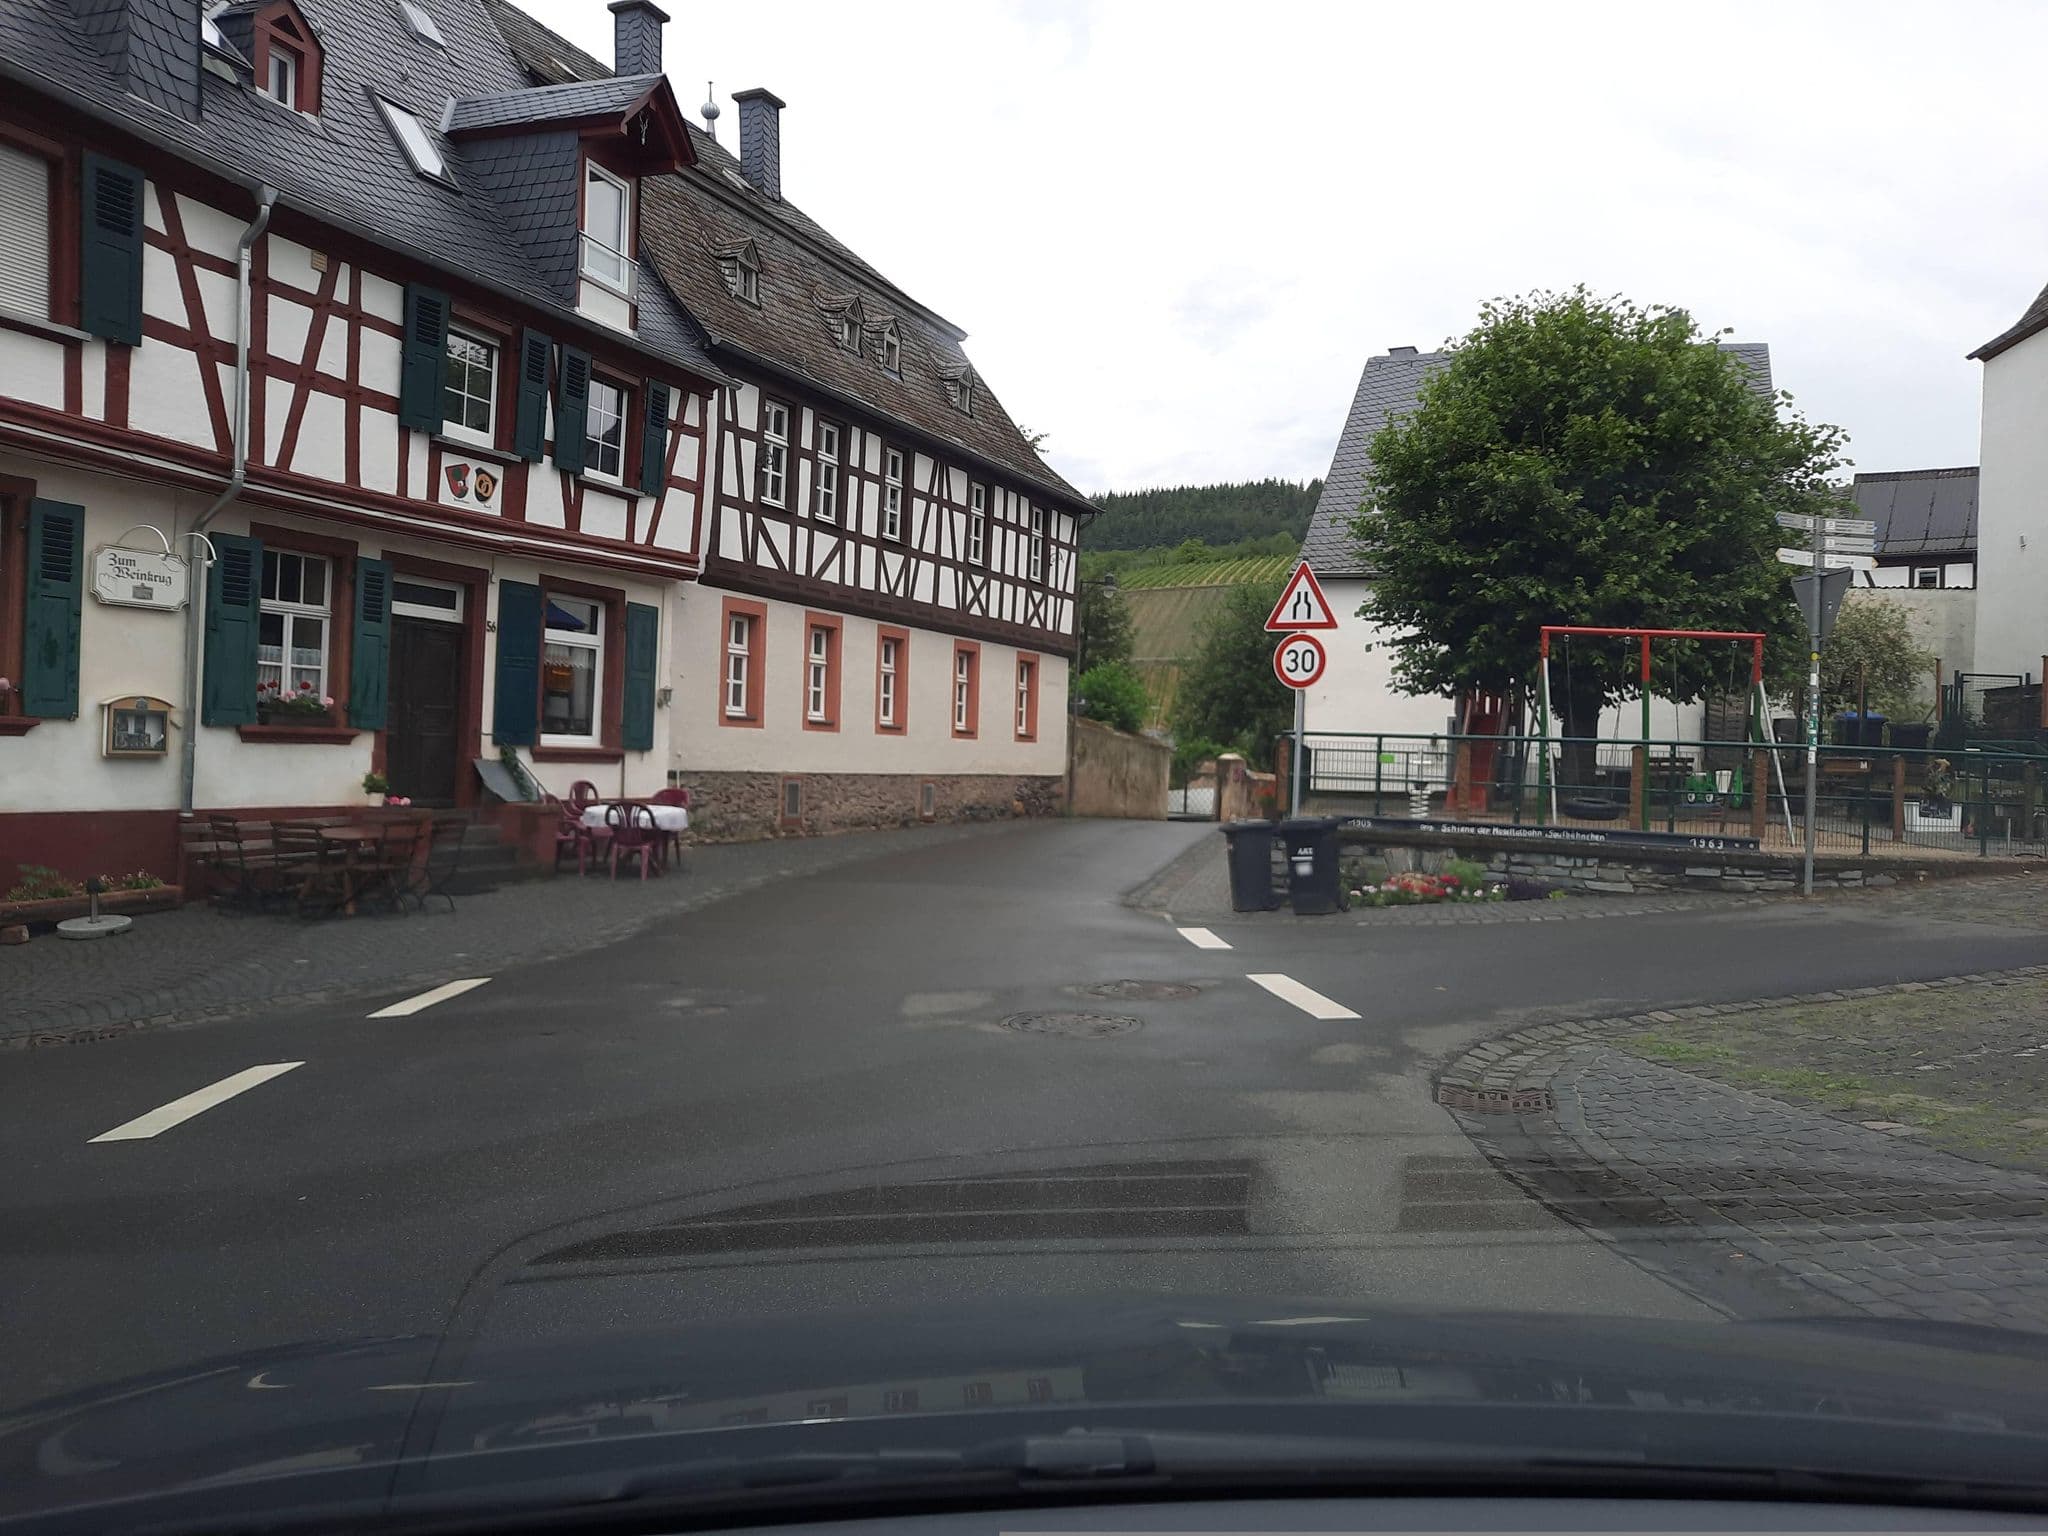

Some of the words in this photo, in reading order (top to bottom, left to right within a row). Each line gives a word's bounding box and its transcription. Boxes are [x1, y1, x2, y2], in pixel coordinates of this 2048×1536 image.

[107, 552, 137, 567] Zum
[112, 566, 172, 587] Weinkrug
[486, 621, 497, 632] 56
[1286, 649, 1315, 673] 30
[1689, 838, 1724, 850] 1963
